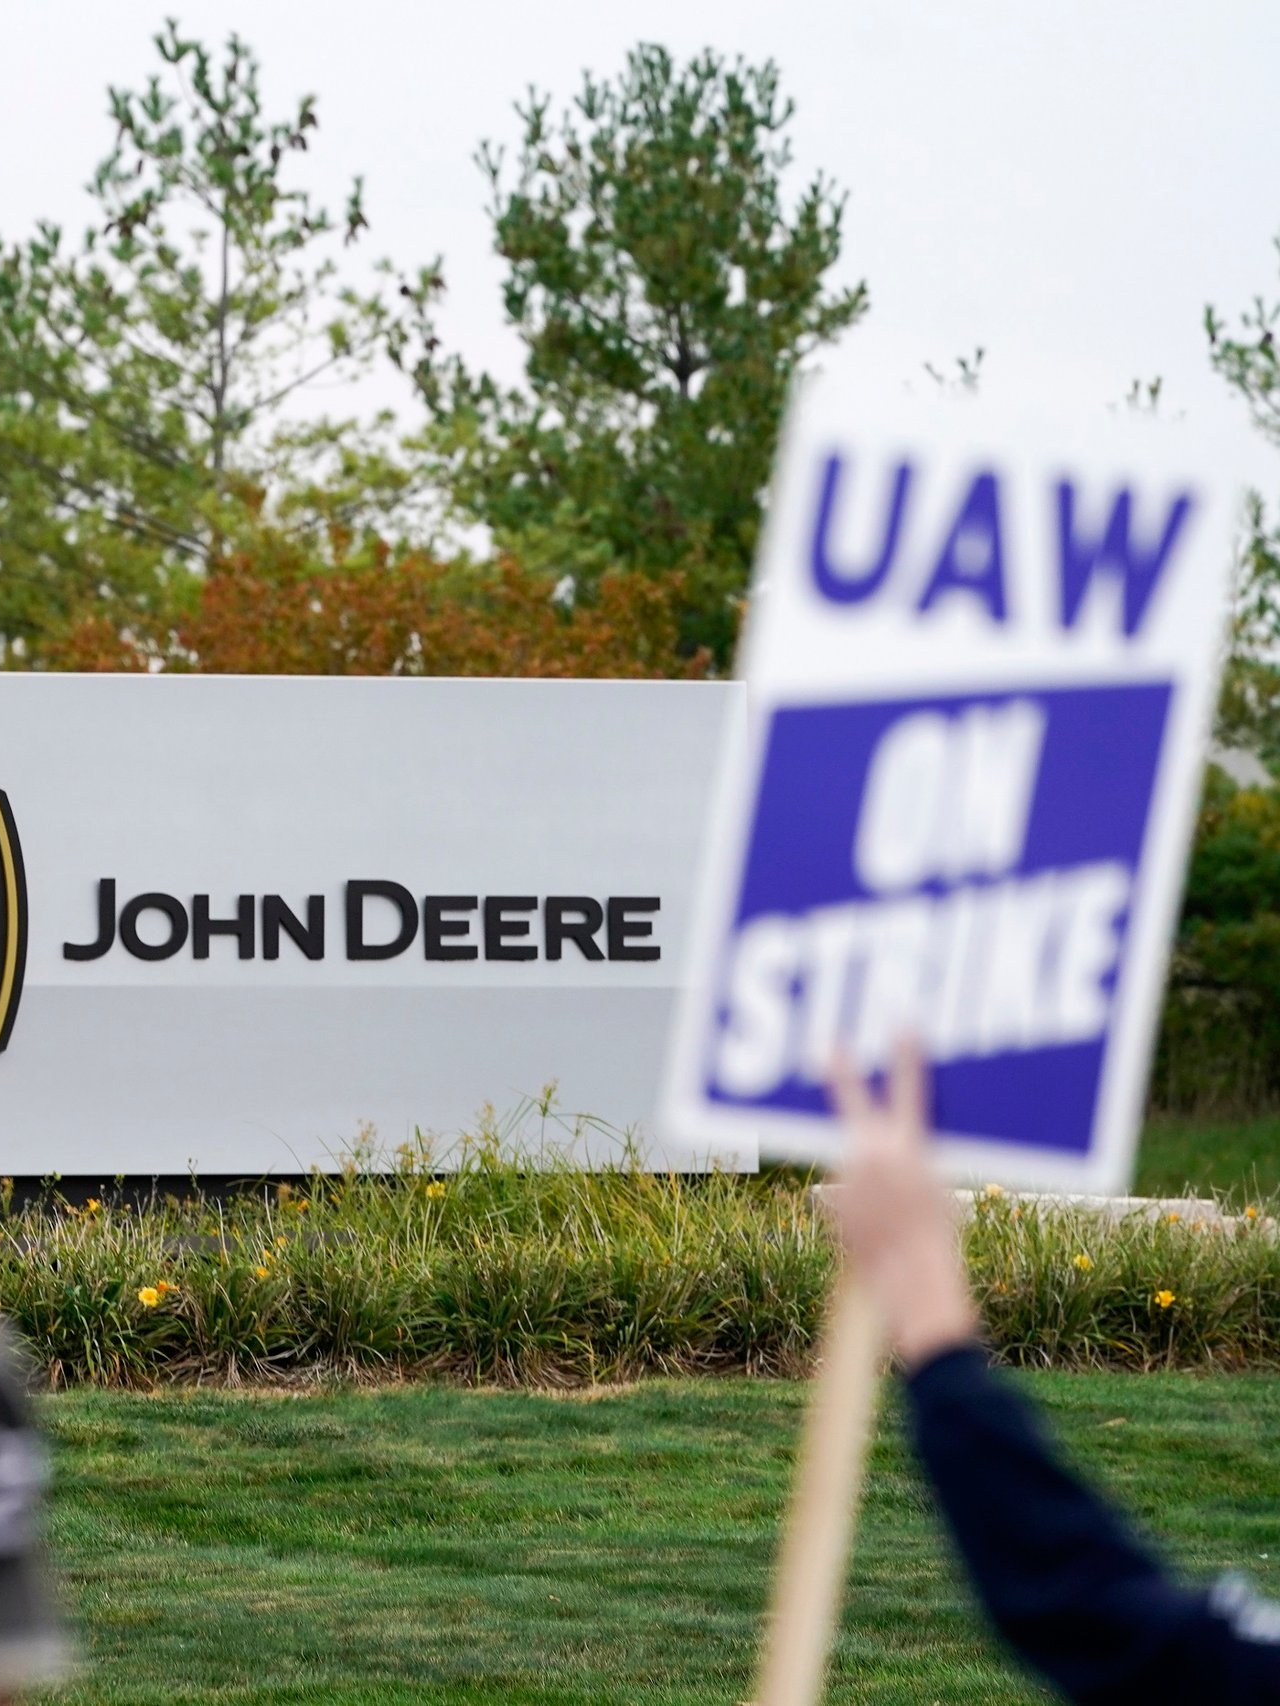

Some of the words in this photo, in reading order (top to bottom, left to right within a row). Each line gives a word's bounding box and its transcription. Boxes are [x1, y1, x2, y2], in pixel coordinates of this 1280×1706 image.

[807, 449, 1197, 641] UAW
[851, 695, 1047, 897] ON
[63, 878, 325, 961] JOHN
[345, 879, 661, 962] DEERE
[716, 857, 1132, 1098] STRIKE
